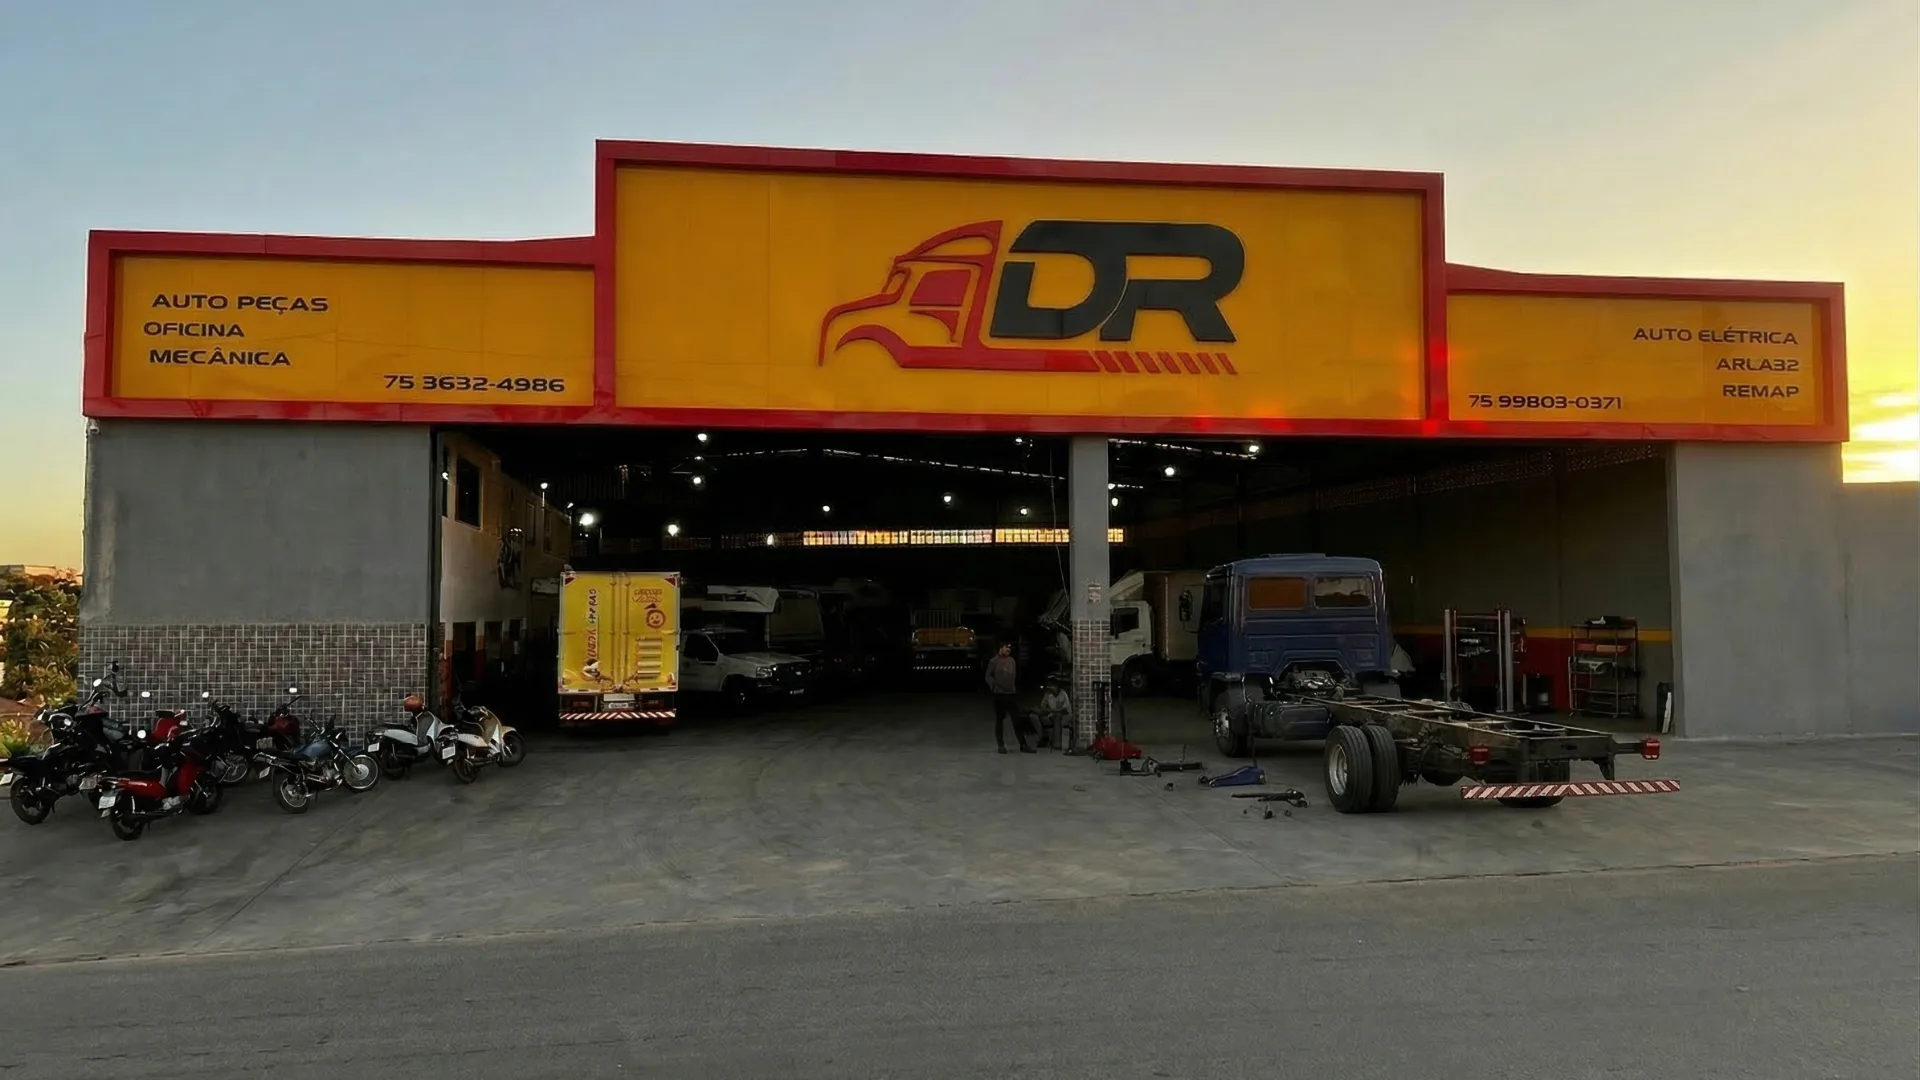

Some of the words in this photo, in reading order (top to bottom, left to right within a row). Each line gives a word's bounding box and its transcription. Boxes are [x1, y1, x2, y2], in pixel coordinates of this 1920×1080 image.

[989, 219, 1245, 343] DR
[152, 294, 228, 310] AUTO
[237, 295, 329, 315] PEÇAS
[143, 321, 245, 338] OFICINA
[1633, 327, 1692, 342] AUTO
[1698, 326, 1798, 345] ELÉTRICA
[149, 346, 291, 366] MECÂNICA
[1716, 358, 1799, 372] ARLA32
[384, 375, 415, 390] 75
[422, 375, 565, 393] 3632-4986
[1722, 384, 1799, 398] REMAP
[1469, 394, 1493, 408] 75
[1498, 395, 1621, 409] 99803-0371
